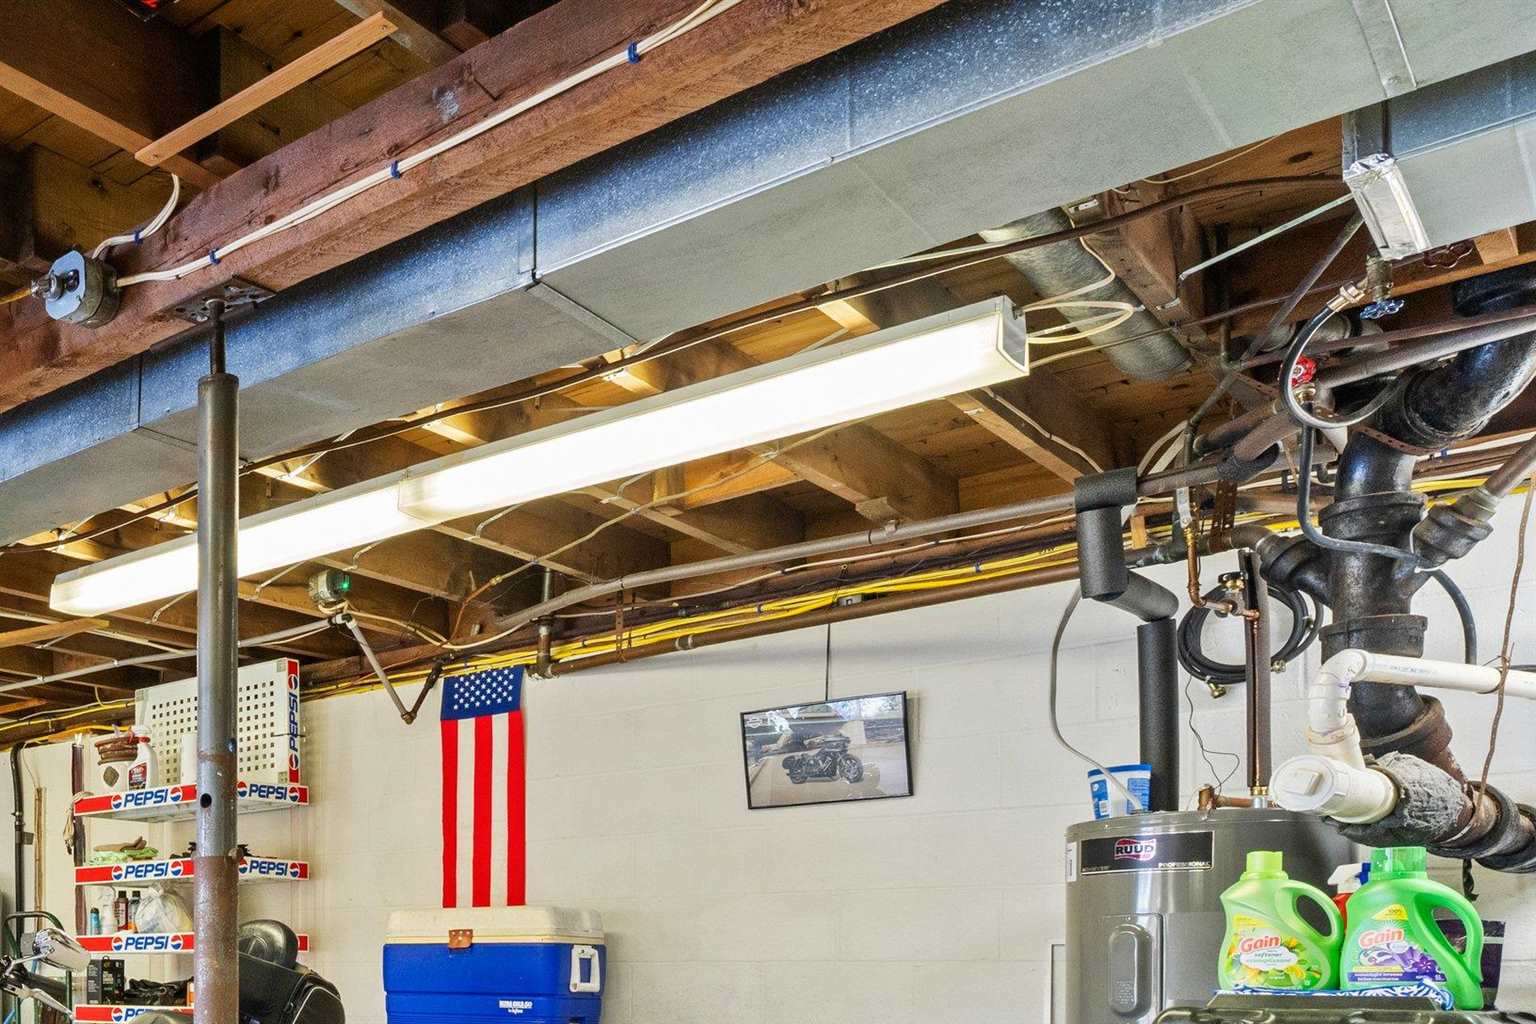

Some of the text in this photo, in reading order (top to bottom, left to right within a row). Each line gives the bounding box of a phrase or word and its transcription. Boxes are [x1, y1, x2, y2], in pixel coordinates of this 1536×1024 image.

[288, 692, 298, 752] PEPSI
[124, 788, 168, 808] PEPSI
[248, 783, 288, 801] PEPSI
[1115, 844, 1154, 855] RUUD
[124, 862, 169, 879] PEPSI
[249, 860, 289, 876] PEPSI
[124, 935, 169, 951] PEPSI
[1240, 935, 1281, 952] Gain
[1359, 928, 1403, 949] Gain
